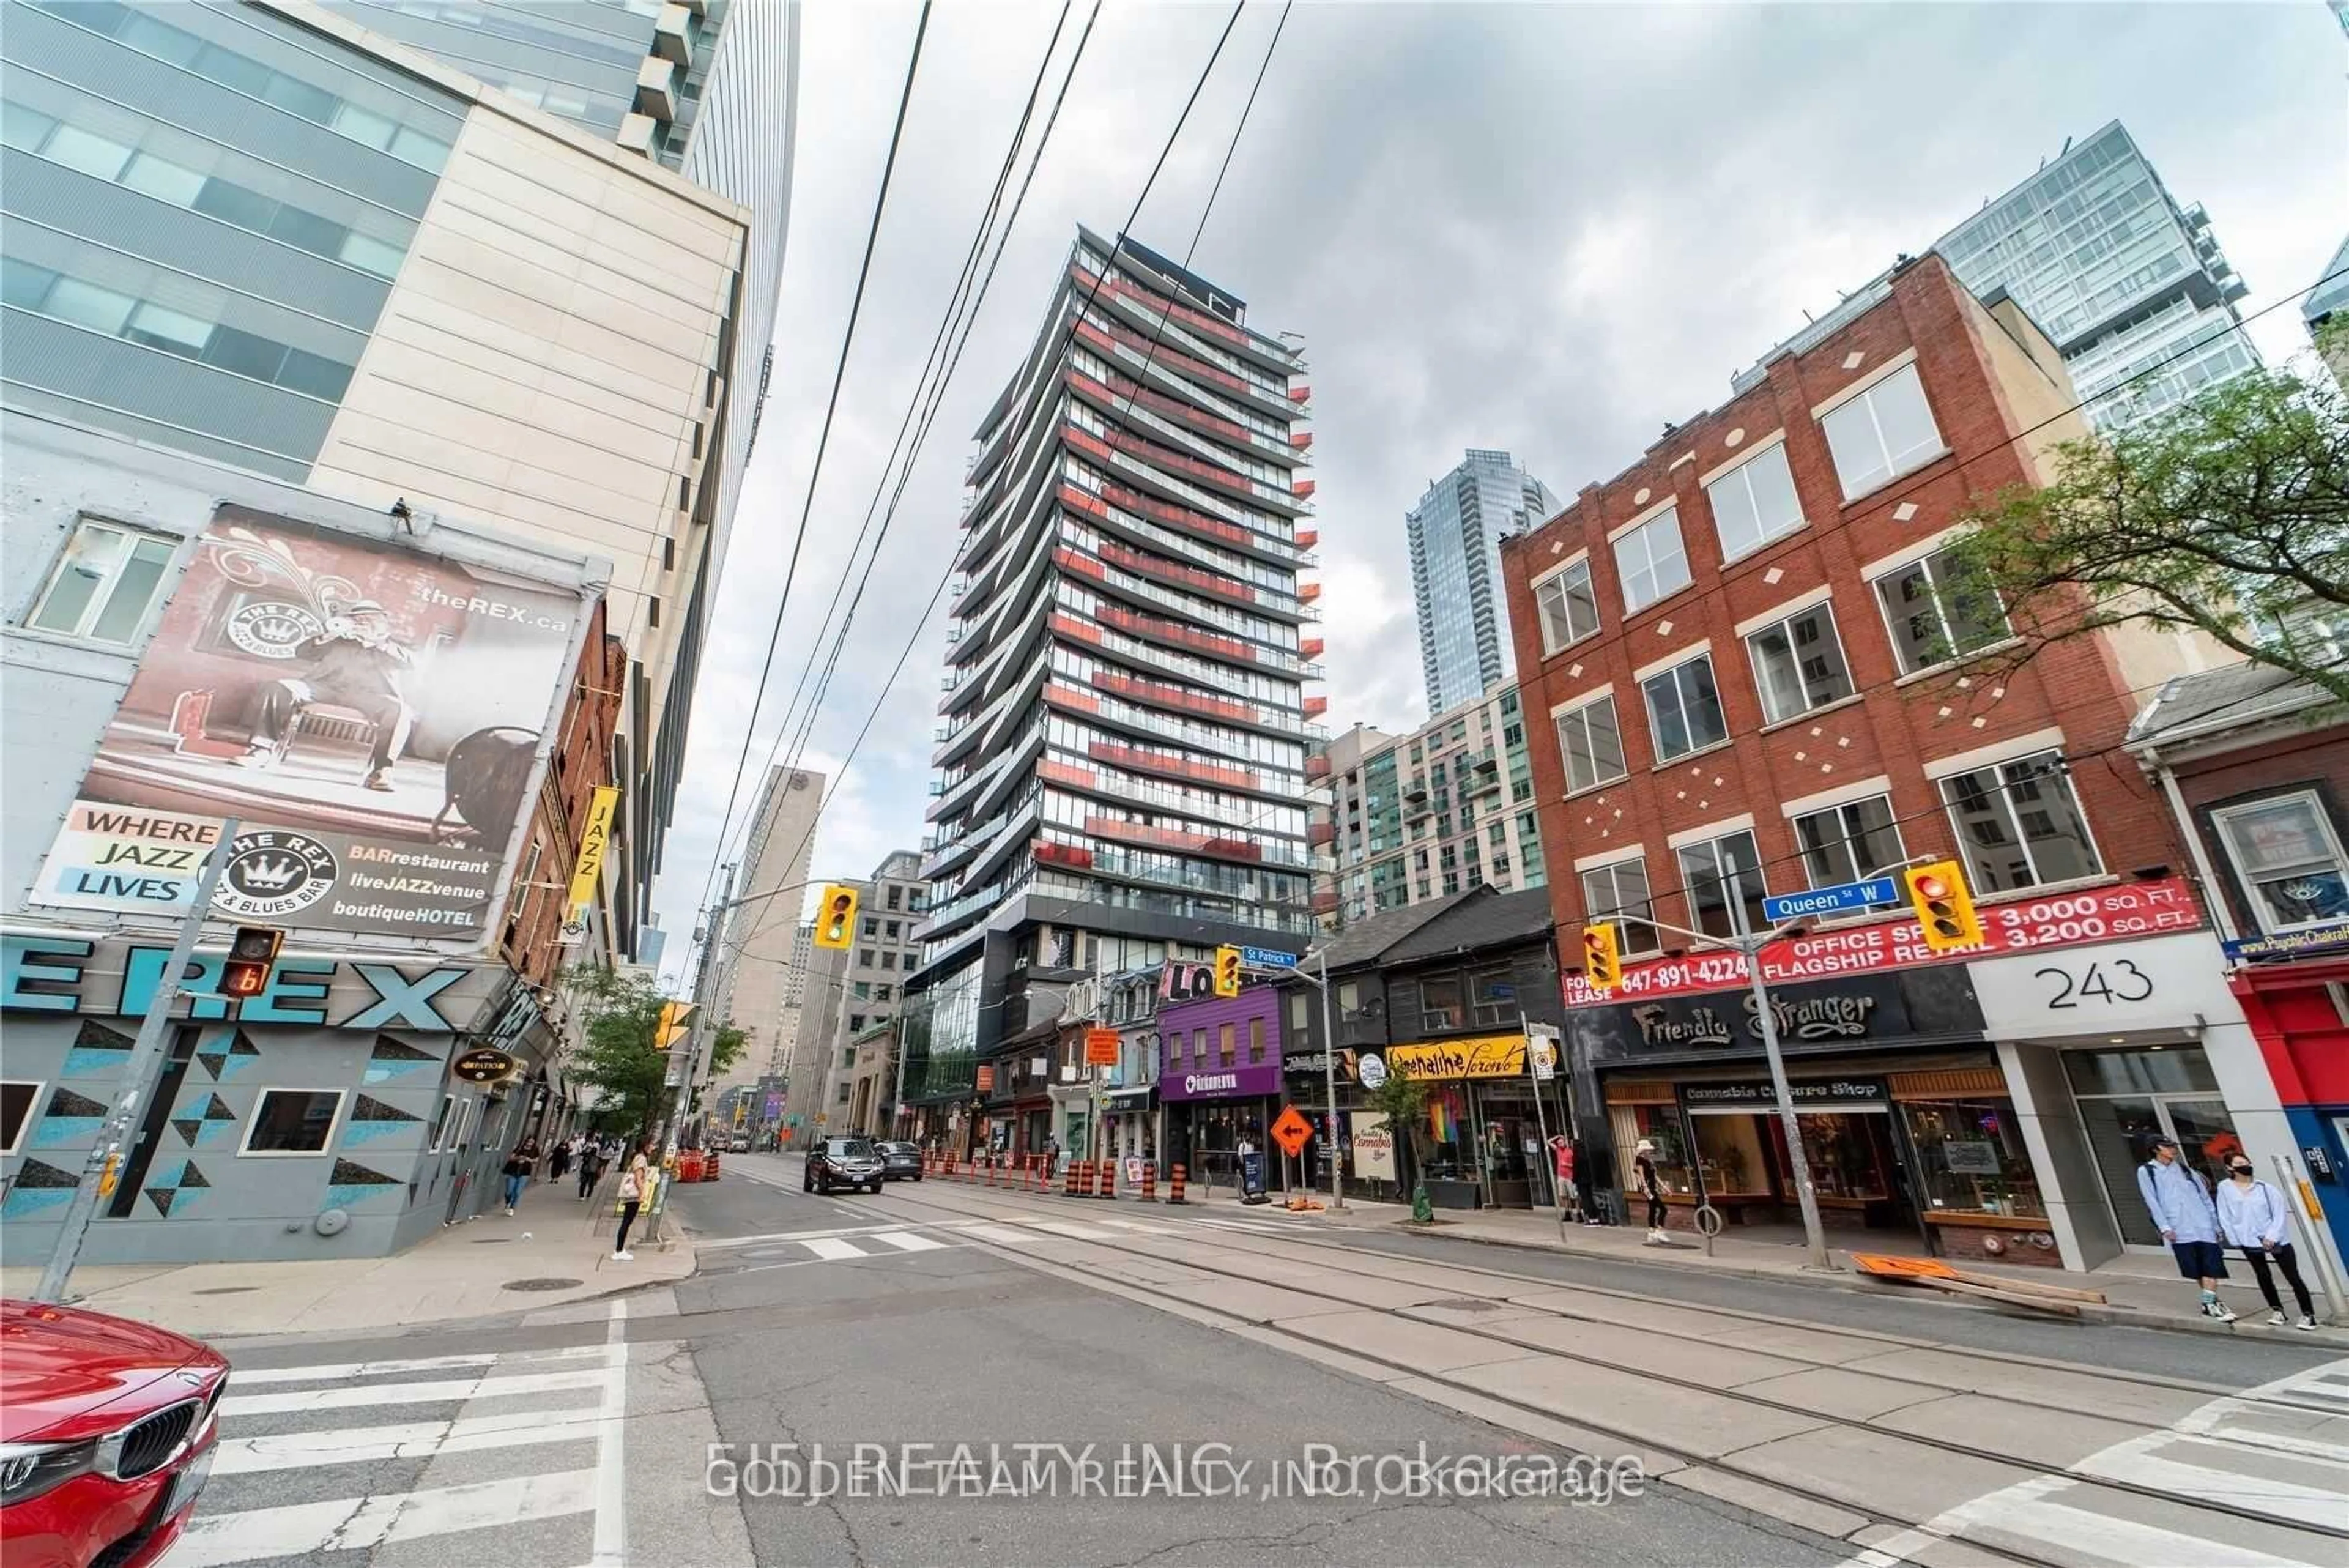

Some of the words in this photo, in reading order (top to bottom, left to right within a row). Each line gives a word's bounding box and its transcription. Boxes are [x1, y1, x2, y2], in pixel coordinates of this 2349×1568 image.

[422, 588, 566, 633] theREX.ca
[86, 811, 219, 845] WHERE
[581, 806, 605, 875] JAZZ
[95, 842, 195, 870] JAZZ
[228, 834, 275, 858] HE
[286, 836, 332, 870] REX
[348, 845, 491, 874] BARrestaurant
[76, 873, 182, 901] LIVES
[223, 895, 239, 907] &
[239, 897, 297, 914] BLUES
[297, 879, 327, 903] BAR
[349, 872, 486, 899] liveJAZZvenue
[1778, 893, 1839, 916] Queen
[1841, 889, 1854, 899] St
[1860, 885, 1878, 902] W
[333, 899, 475, 926] boutiqueHOTEL
[1792, 929, 1884, 957] OFFICE
[1891, 914, 1989, 942] SPE
[1998, 896, 2099, 927] 3,000
[2104, 894, 2146, 911] SQ.
[1248, 949, 1256, 960] St
[1258, 950, 1284, 963] Patrick
[1763, 949, 1885, 979] FLAGSHIP
[2005, 917, 2107, 947] 3,200
[2112, 916, 2153, 933] SQ.
[117, 945, 470, 1031] REX
[1621, 956, 1750, 993] 647-891-4224
[2035, 959, 2153, 1009] 243
[1567, 986, 1613, 1005] LEASE
[1632, 1003, 1733, 1046] Friendly
[1743, 992, 1874, 1039] Stranger
[1760, 1085, 1827, 1098] Cuture
[1831, 1082, 1878, 1098] Shop
